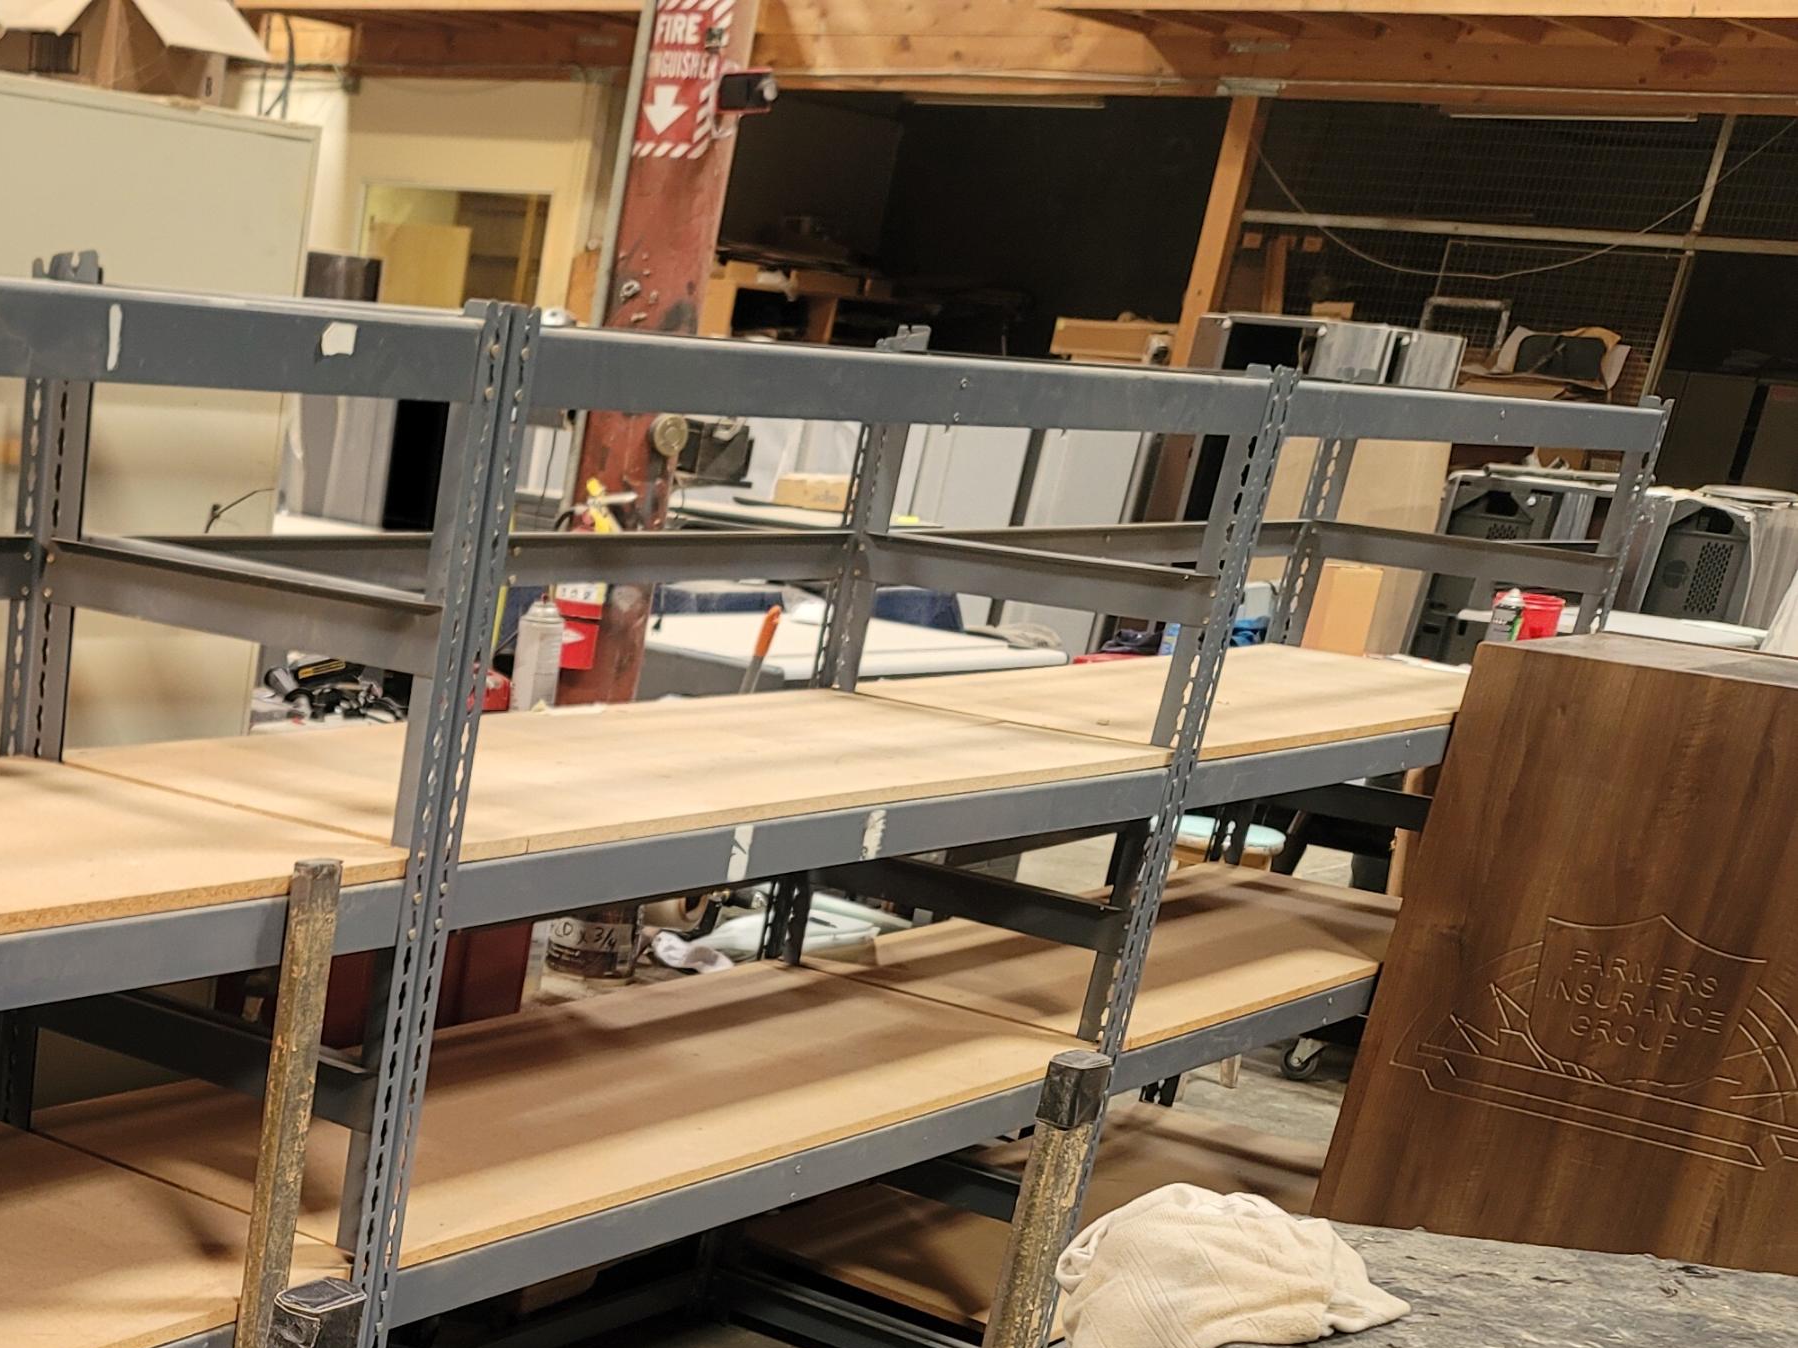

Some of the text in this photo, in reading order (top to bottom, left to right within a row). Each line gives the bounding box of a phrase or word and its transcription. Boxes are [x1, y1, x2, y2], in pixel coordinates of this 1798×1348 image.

[654, 12, 703, 46] FIRE
[1568, 949, 1718, 999] FARMERS
[1545, 977, 1726, 1034] INSURANCE
[1569, 1014, 1678, 1054] GROUP
